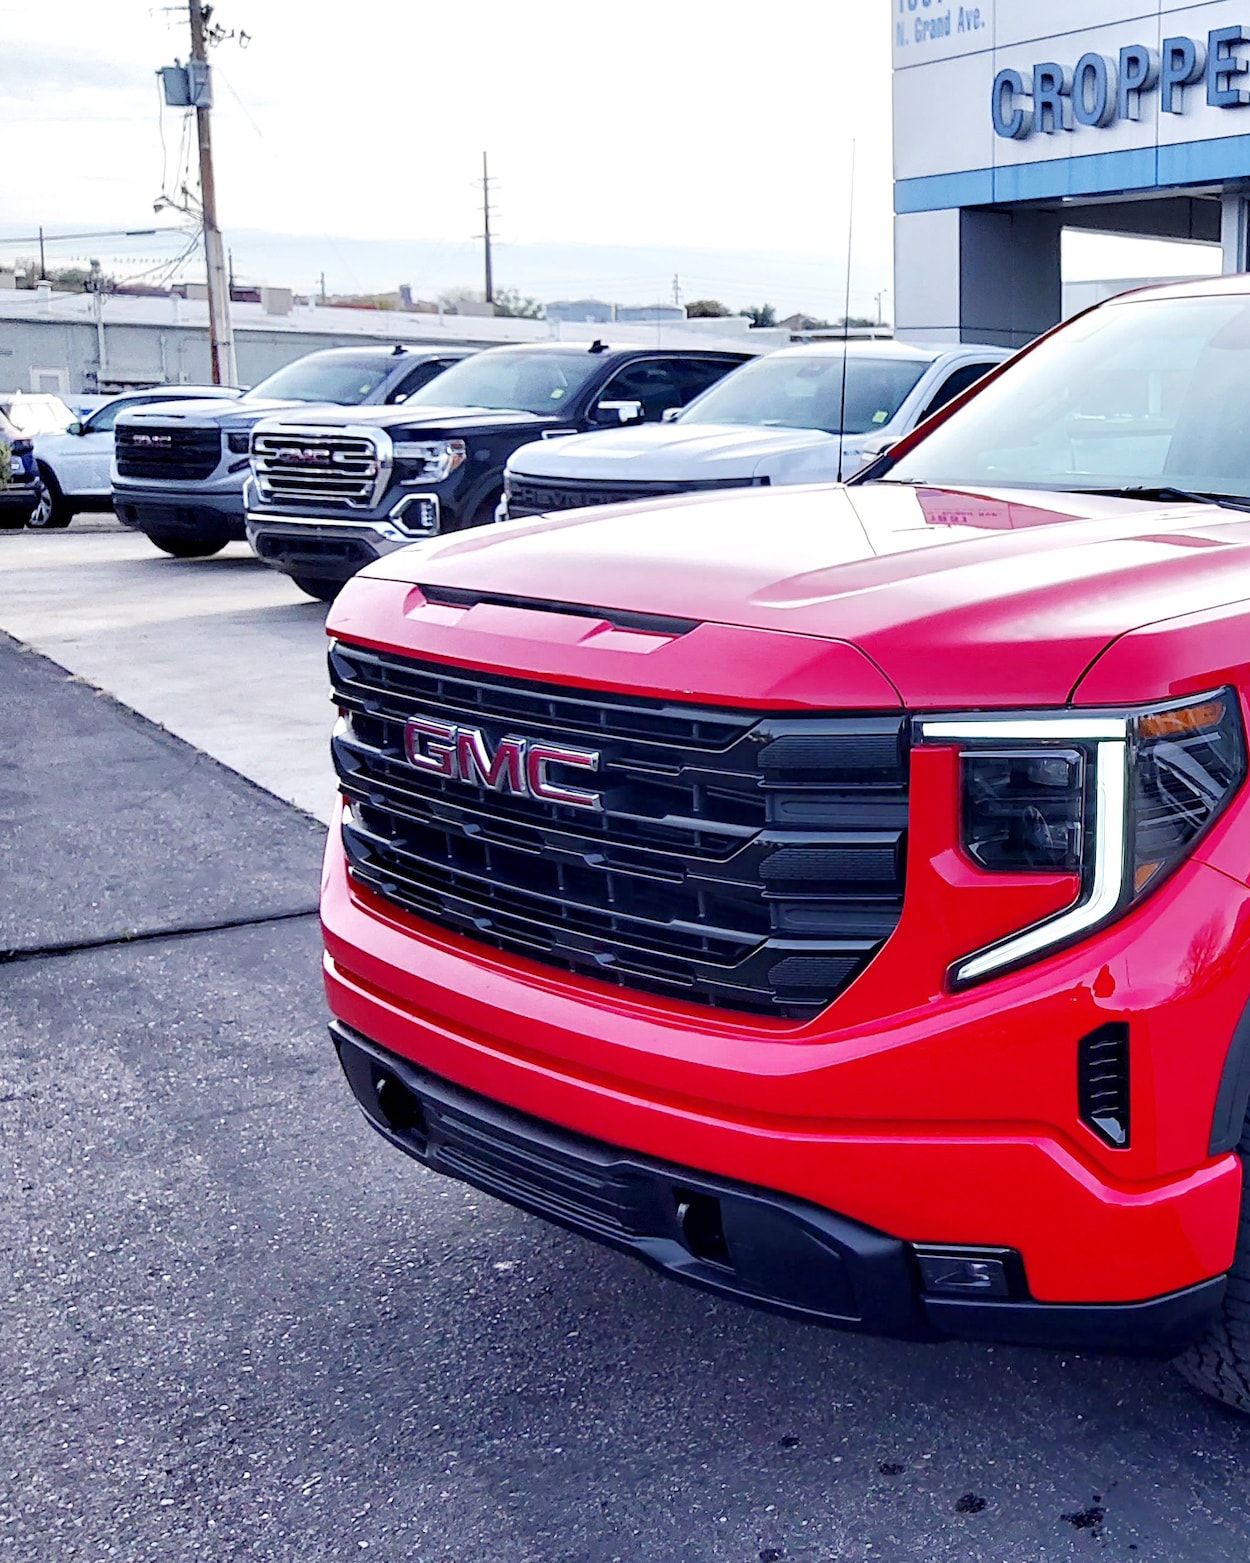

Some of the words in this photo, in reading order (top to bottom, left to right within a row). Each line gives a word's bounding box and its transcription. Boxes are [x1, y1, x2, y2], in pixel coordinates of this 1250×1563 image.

[915, 10, 951, 43] Grand
[958, 6, 985, 33] Ave.
[404, 713, 604, 811] GMC
